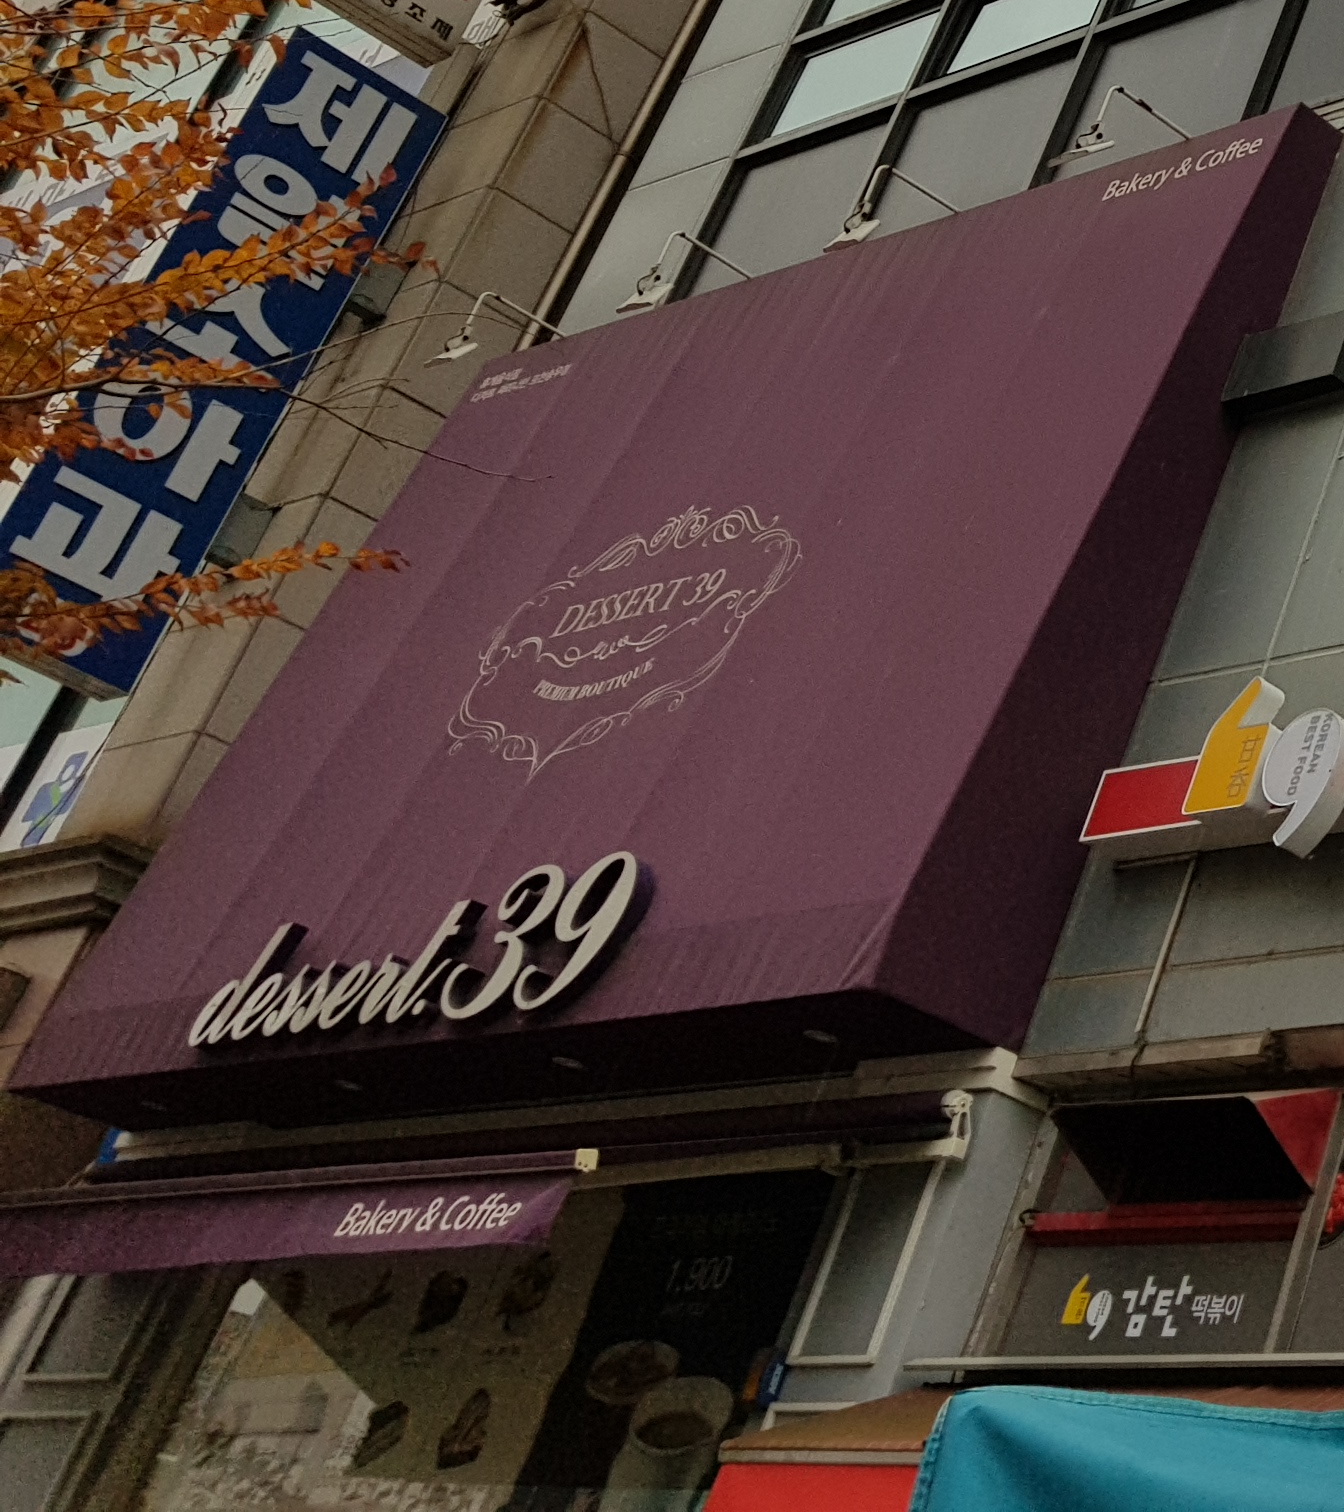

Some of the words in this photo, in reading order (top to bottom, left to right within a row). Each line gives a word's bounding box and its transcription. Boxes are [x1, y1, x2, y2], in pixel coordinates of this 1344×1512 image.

[1101, 166, 1175, 202] Bakery
[1174, 156, 1193, 180] &
[1195, 138, 1264, 172] Coffee
[9, 50, 418, 600] 제일소아과
[549, 576, 692, 638] DESSERT
[682, 568, 727, 606] 39
[576, 657, 656, 699] BOUTIQUE
[1301, 714, 1322, 752] BEST
[1306, 712, 1335, 774] KOREAN
[1287, 756, 1307, 797] FOOD
[333, 1199, 414, 1238] Bakery
[416, 1195, 445, 1229] &
[440, 1192, 523, 1229] Coffee
[1121, 1274, 1195, 1338] 감탄
[1190, 1293, 1246, 1325] 떡볶이
